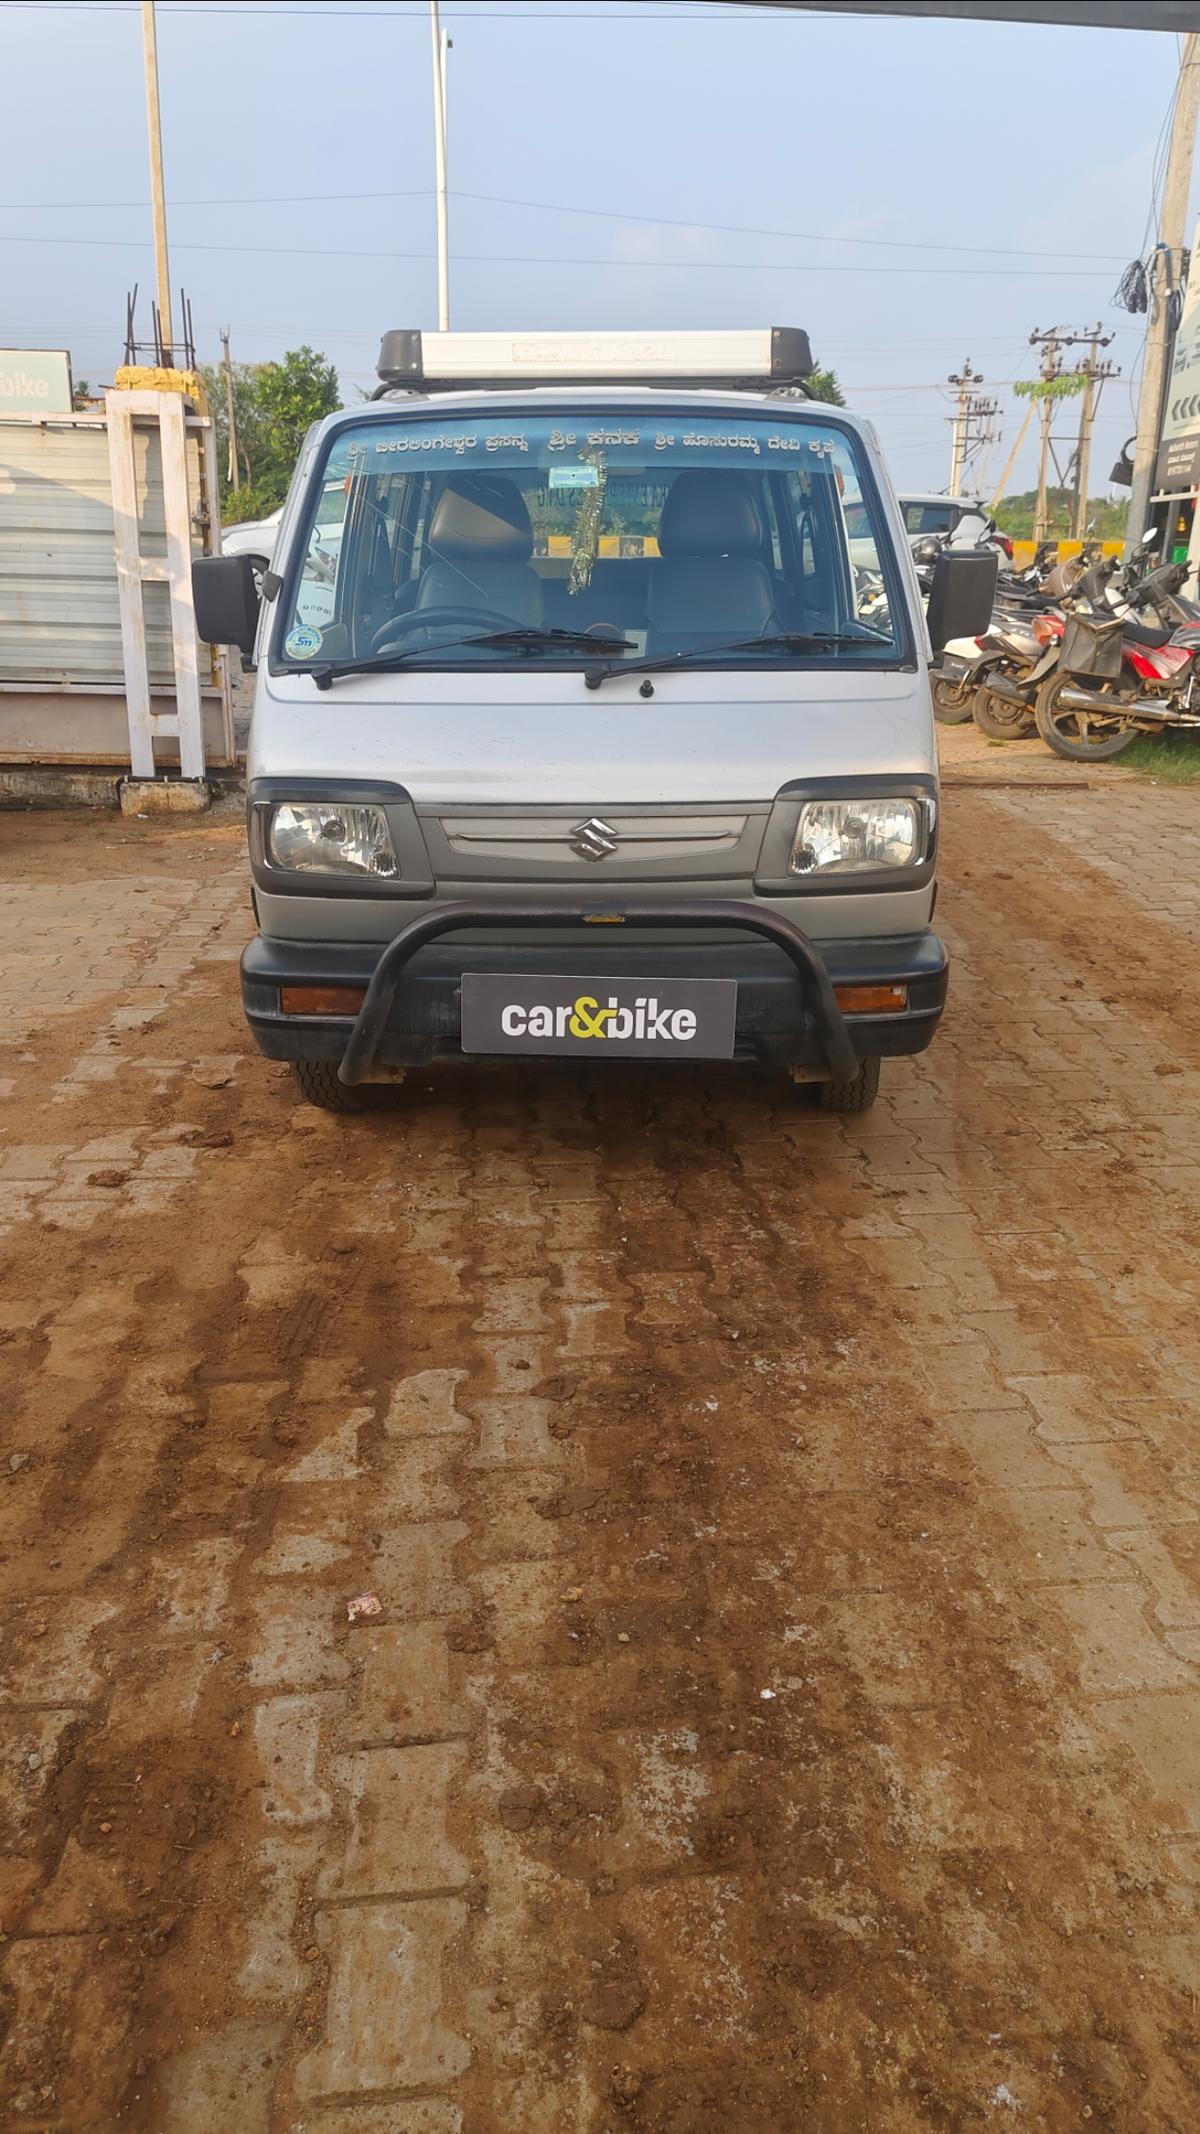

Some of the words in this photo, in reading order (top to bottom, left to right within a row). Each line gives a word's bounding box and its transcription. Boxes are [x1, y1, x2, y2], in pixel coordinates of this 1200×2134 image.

[485, 432, 528, 452] ಪ್ರಸನ್ನ
[548, 428, 576, 452] ಶ್ರೀ
[655, 431, 675, 451] ಶ್ರೀ
[501, 996, 697, 1041] car&bike
